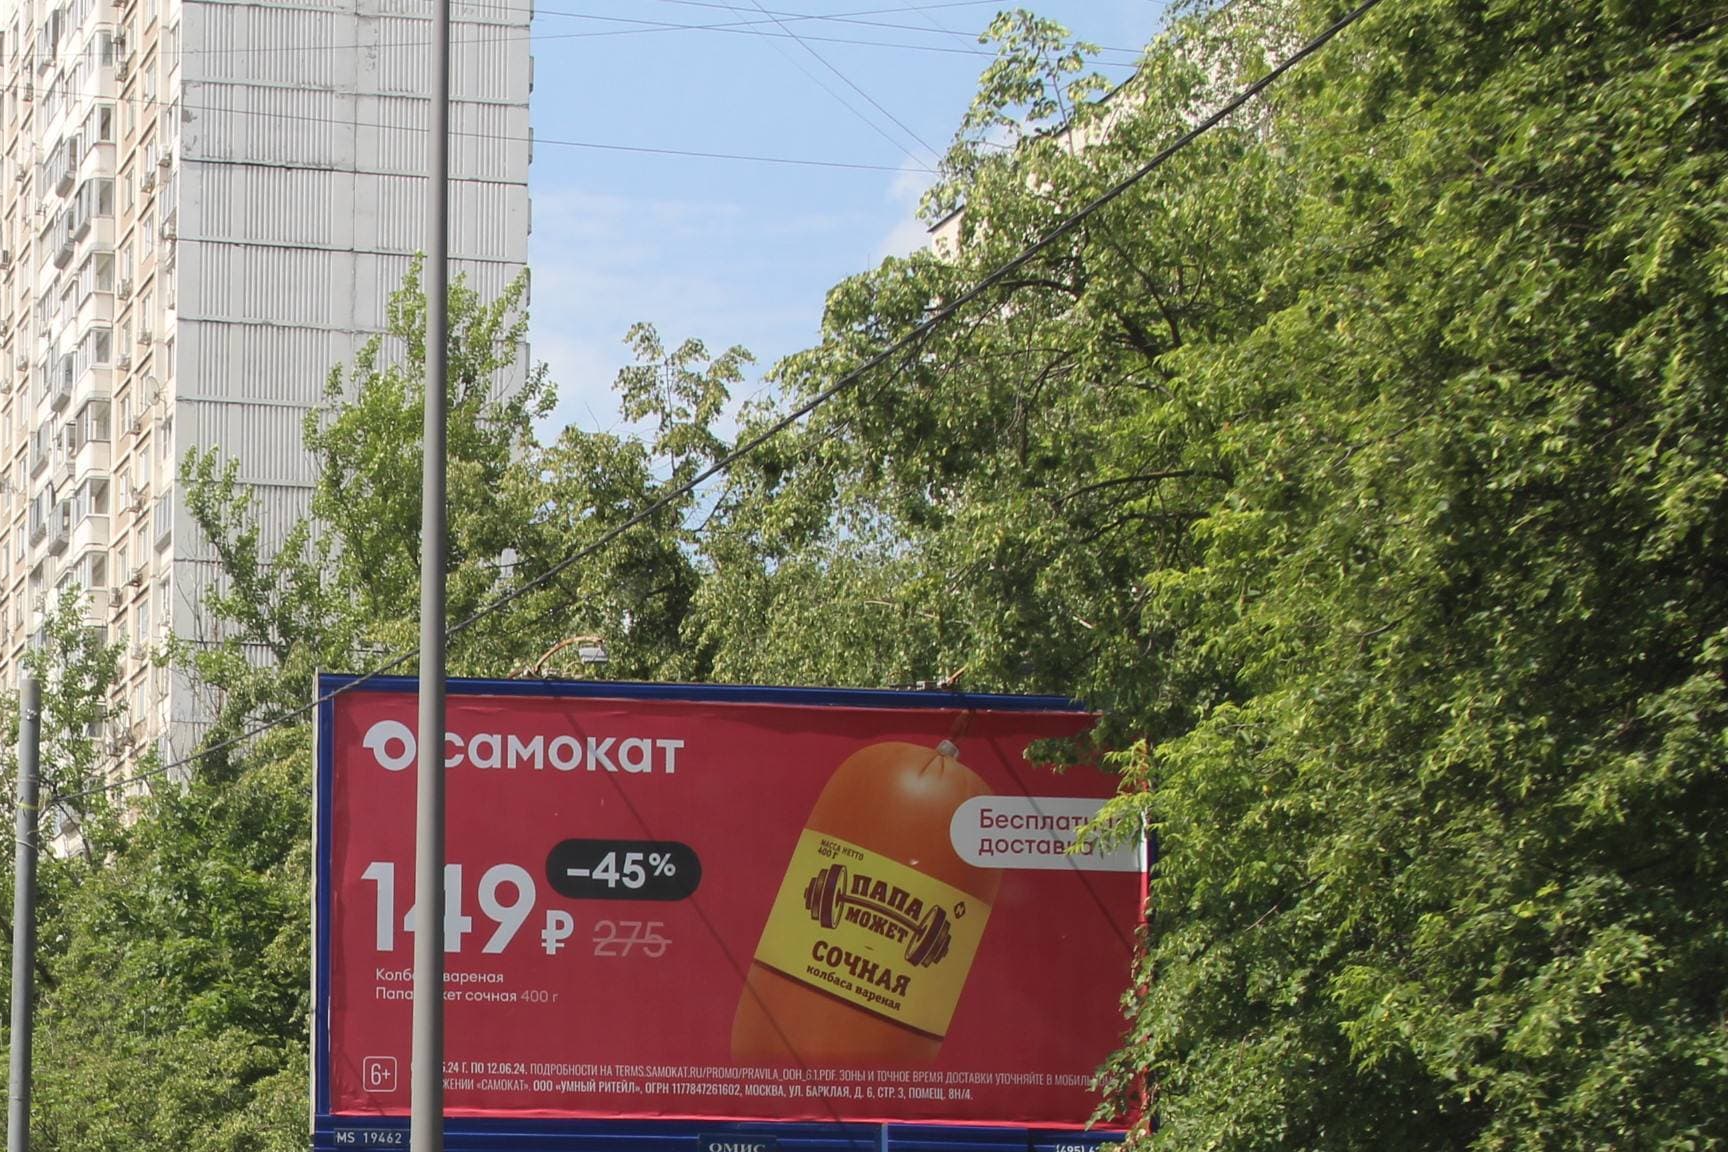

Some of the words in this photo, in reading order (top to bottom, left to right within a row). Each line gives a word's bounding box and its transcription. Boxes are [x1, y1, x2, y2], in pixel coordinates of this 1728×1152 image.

[850, 874, 924, 921] ПАПА
[845, 907, 908, 944] МОЖЕТ
[375, 968, 415, 982] Колб
[443, 971, 504, 984] вареная
[812, 940, 911, 997] СОЧНАЯ
[465, 992, 517, 1002] сочная
[521, 990, 548, 1003] 400
[806, 965, 853, 993] колбаса
[855, 985, 901, 1011] вареная
[371, 1063, 391, 1086] 6+
[471, 1062, 485, 1074] ПО
[530, 1063, 598, 1077] ПОДРОБНОСТИ
[600, 1065, 613, 1077] НА
[839, 1070, 866, 1082] ЗОНЫ
[867, 1071, 875, 1082] И
[876, 1070, 911, 1082] ТОЧНОЕ
[912, 1071, 944, 1083] ВРЕМЯ
[945, 1071, 993, 1084] ДОСТАВКИ
[995, 1072, 1045, 1086] УТОЧНЯЙТЕ
[1046, 1074, 1053, 1086] В
[533, 1080, 553, 1092] ООО
[555, 1079, 597, 1093] «УМНЫЙ
[645, 1082, 669, 1094] ОГРН
[337, 1132, 355, 1143] MS
[363, 1132, 402, 1143] 19462
